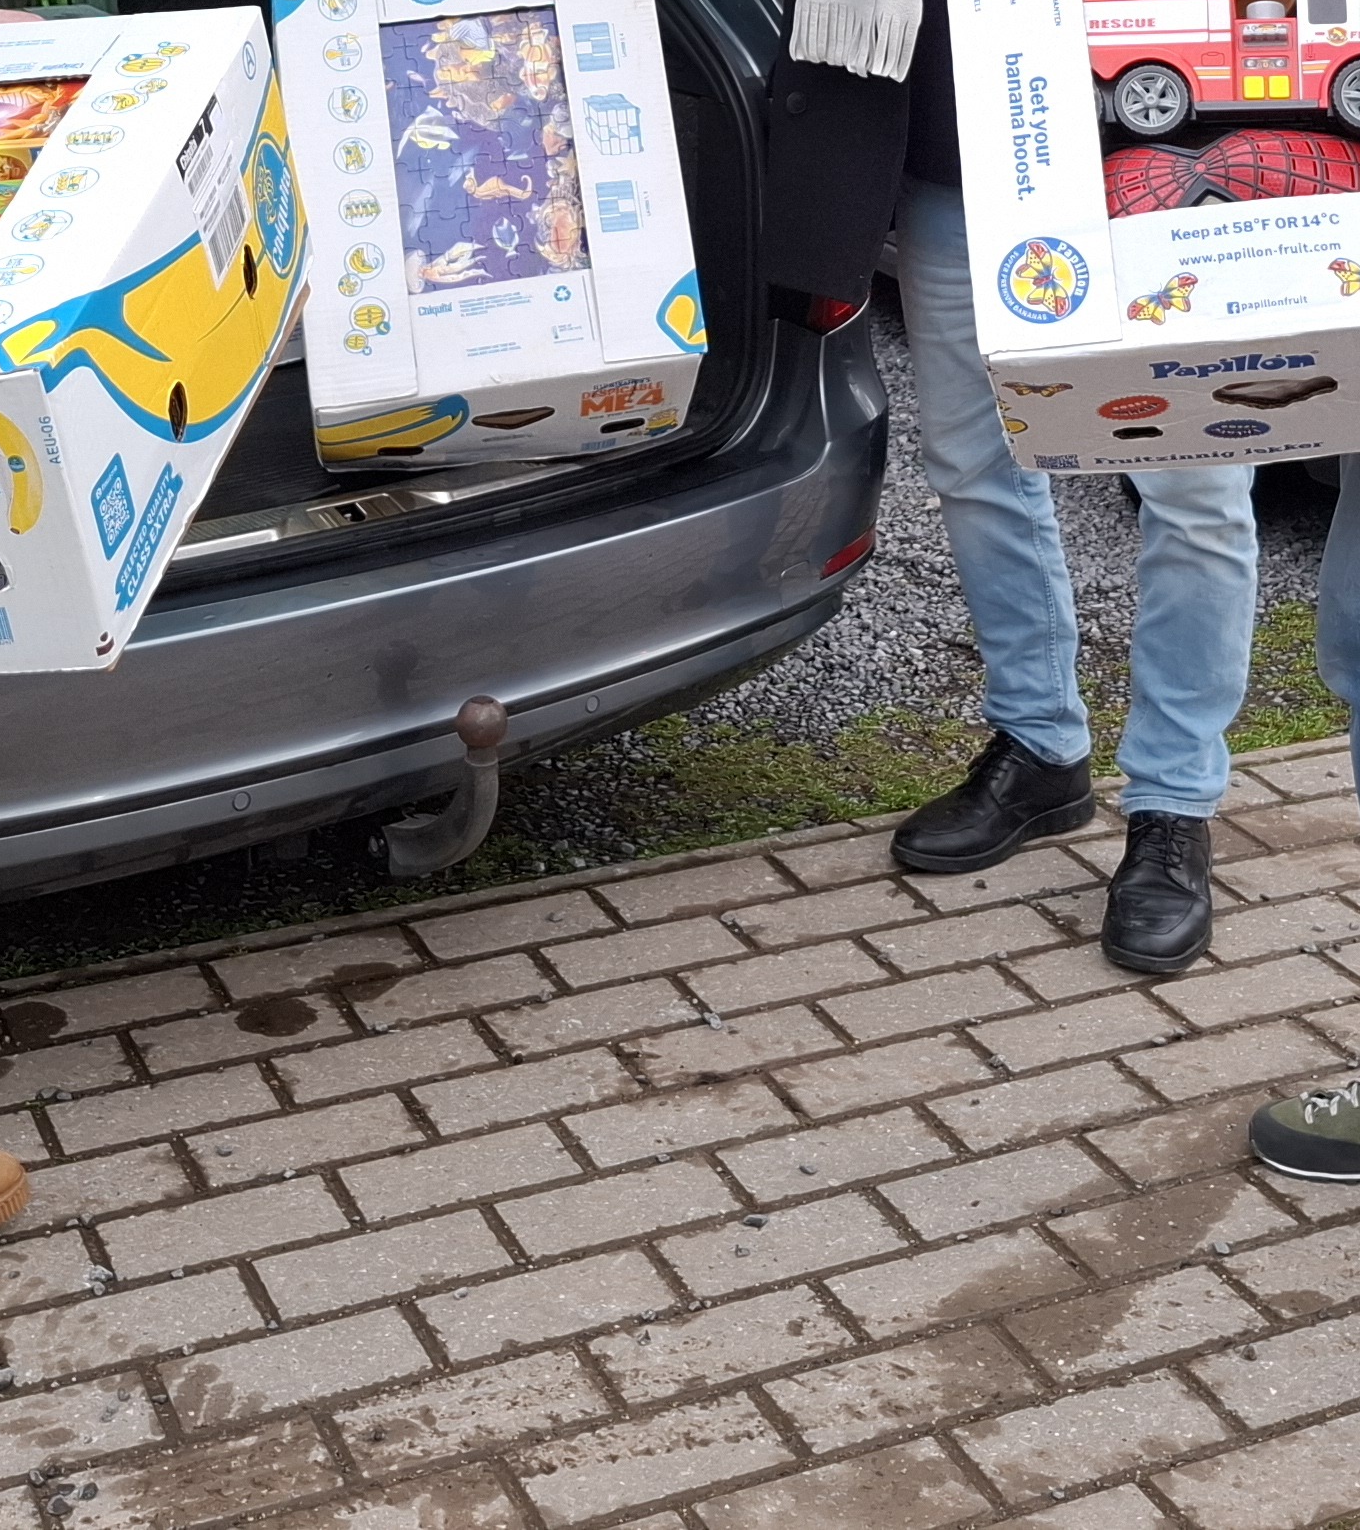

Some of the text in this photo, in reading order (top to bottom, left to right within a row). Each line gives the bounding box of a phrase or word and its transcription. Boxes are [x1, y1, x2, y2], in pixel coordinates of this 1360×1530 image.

[1089, 18, 1156, 29] RESCUE
[1004, 52, 1035, 201] banana boost.
[1029, 76, 1050, 166] Get your
[1171, 212, 1340, 241] Keep at 58°F OR 14°C
[1179, 241, 1341, 267] www.papillon-fruit.com
[1241, 295, 1308, 312] papillonfruit
[1149, 353, 1317, 380] Papillon
[636, 389, 665, 405] 4
[38, 415, 62, 465] AEU-06
[120, 471, 170, 587] SELECTED QUALITY
[128, 489, 175, 597] CLASS EXTRA
